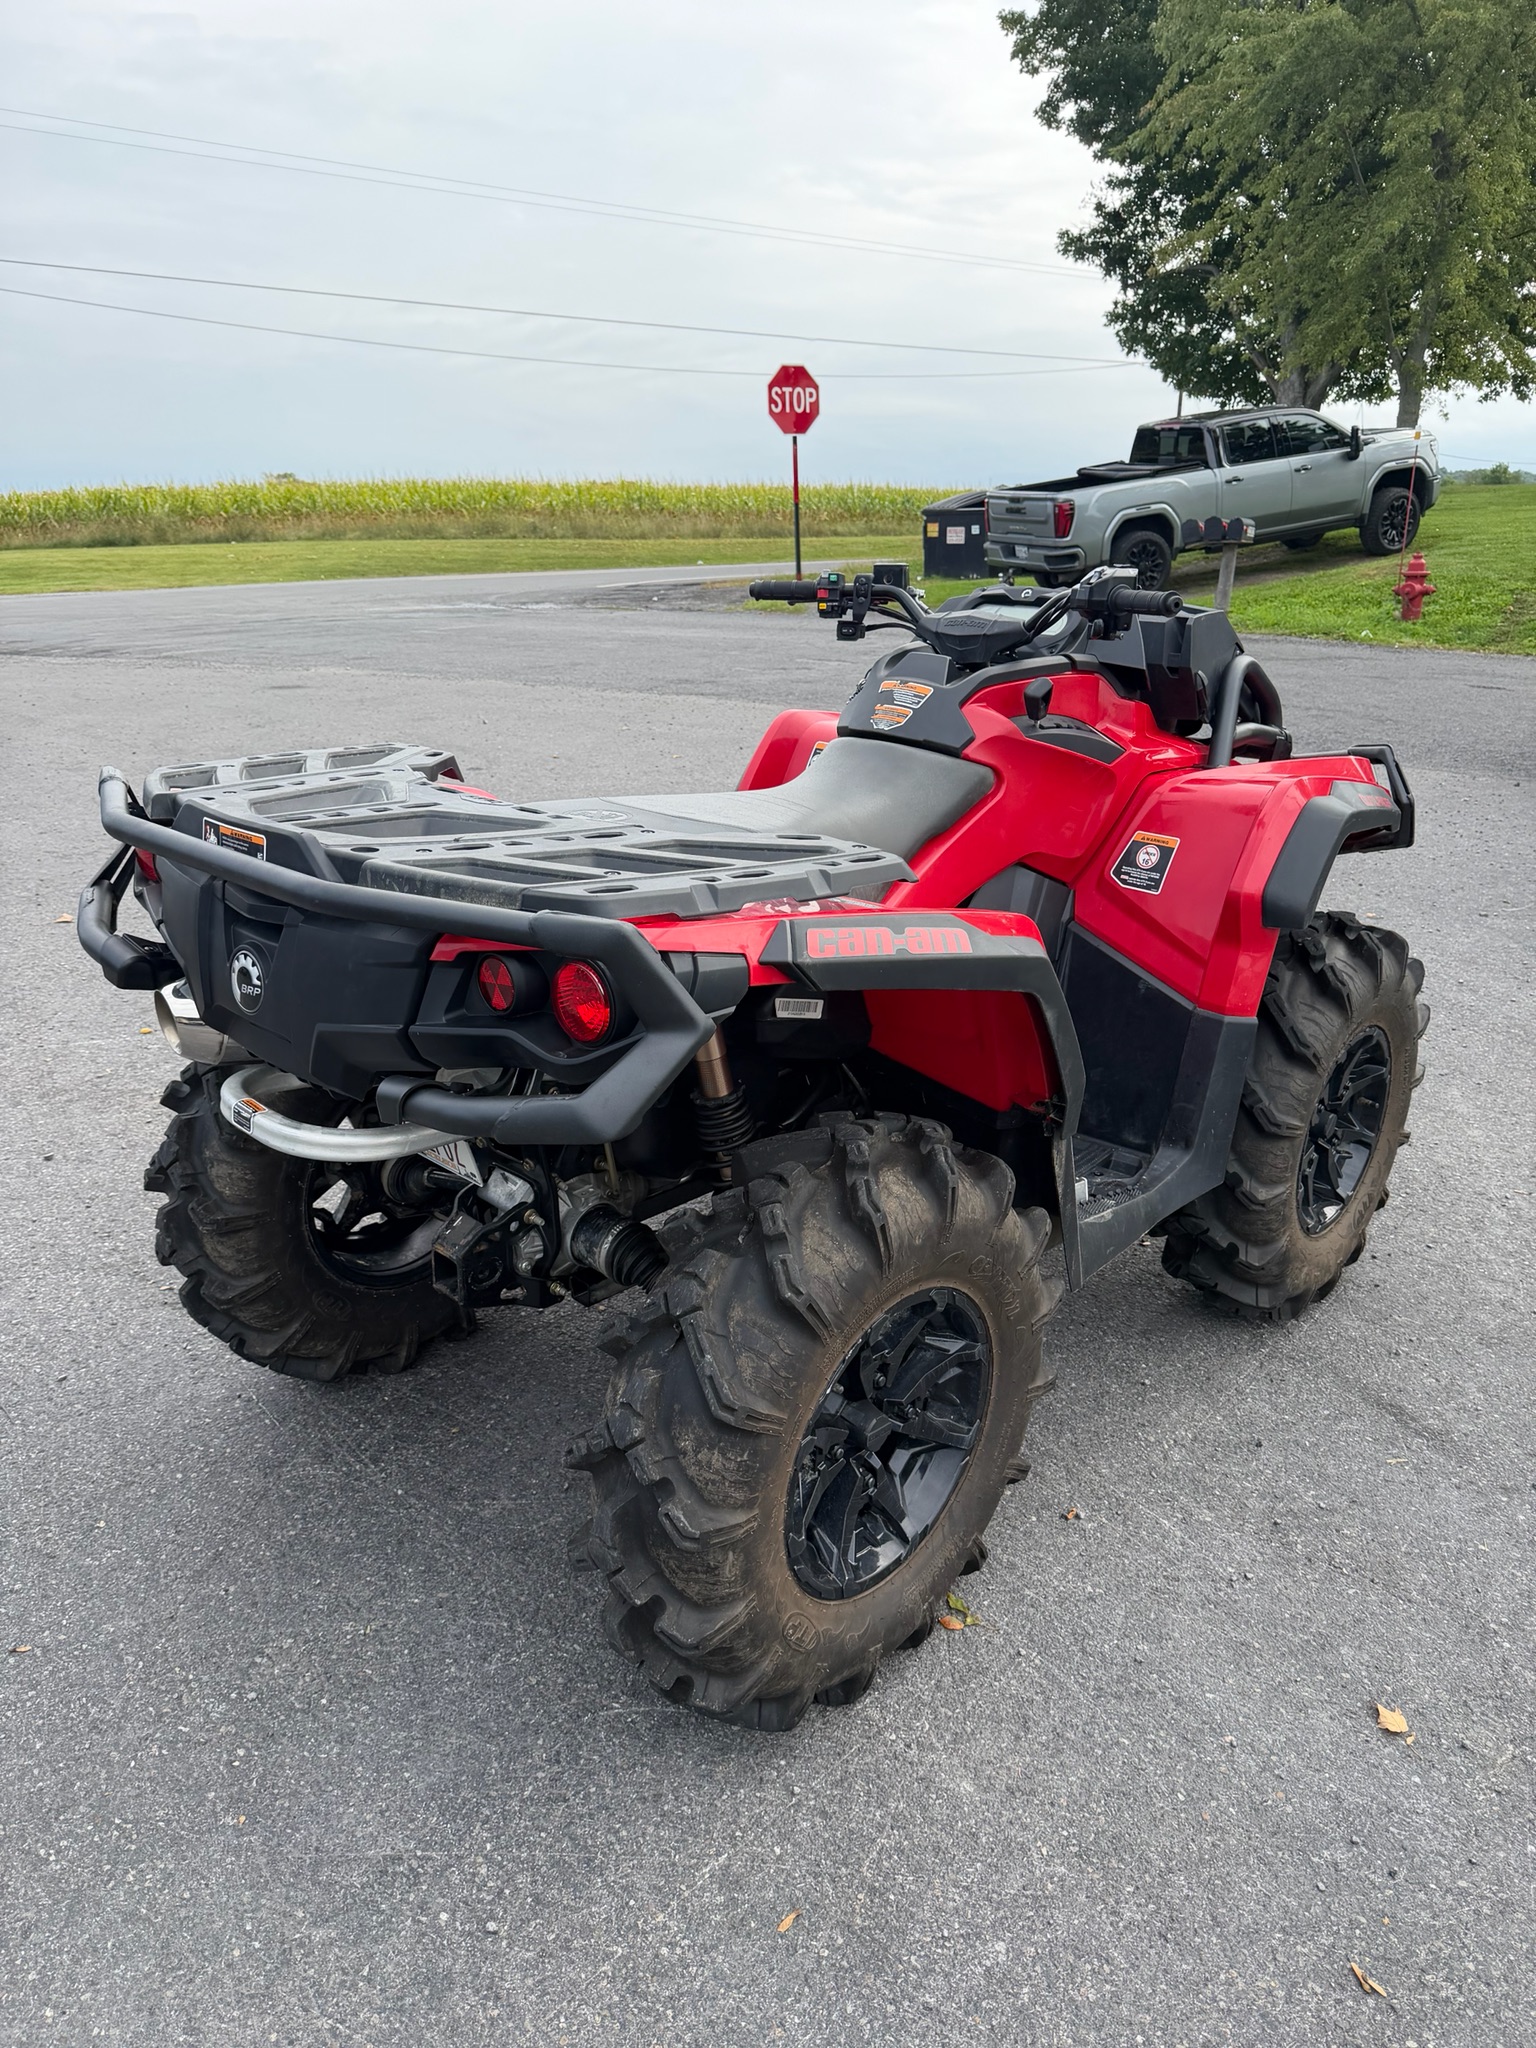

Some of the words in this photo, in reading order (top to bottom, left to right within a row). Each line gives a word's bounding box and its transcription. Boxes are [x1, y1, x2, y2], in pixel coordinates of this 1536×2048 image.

[771, 386, 817, 414] STOP
[1146, 837, 1169, 846] WARNING
[1141, 858, 1150, 866] 16
[806, 927, 973, 959] can-am
[241, 983, 261, 997] BRP
